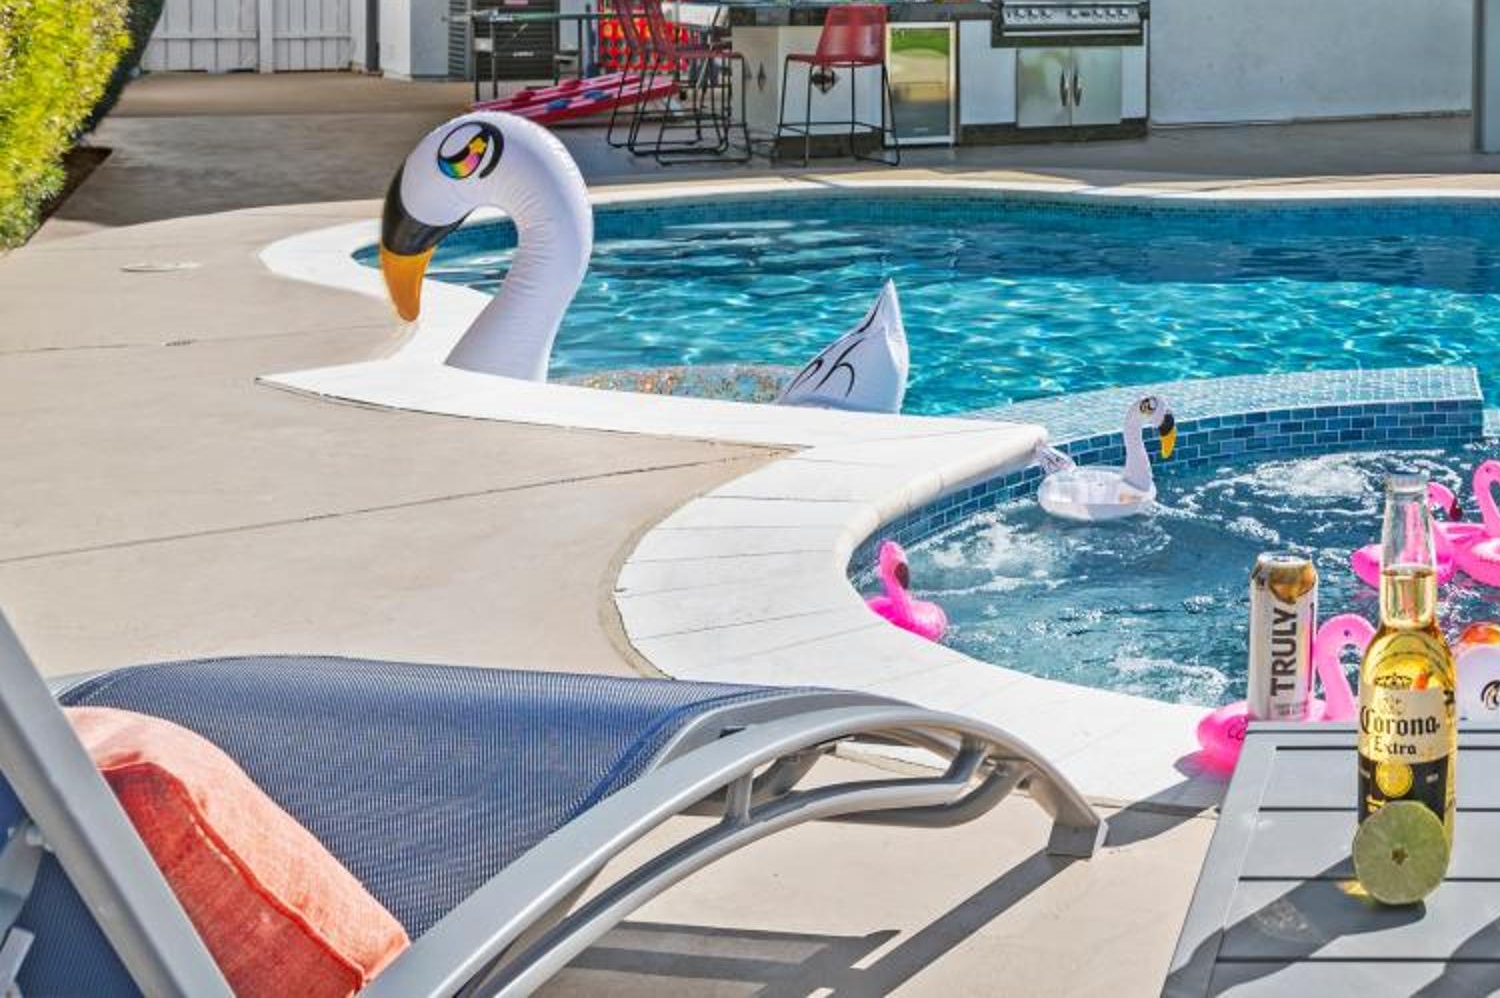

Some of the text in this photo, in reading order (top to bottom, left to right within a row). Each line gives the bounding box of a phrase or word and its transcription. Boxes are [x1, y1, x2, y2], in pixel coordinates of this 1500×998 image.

[1270, 607, 1297, 696] TRULY
[1360, 706, 1440, 736] Corona
[1375, 736, 1417, 755] Extra
